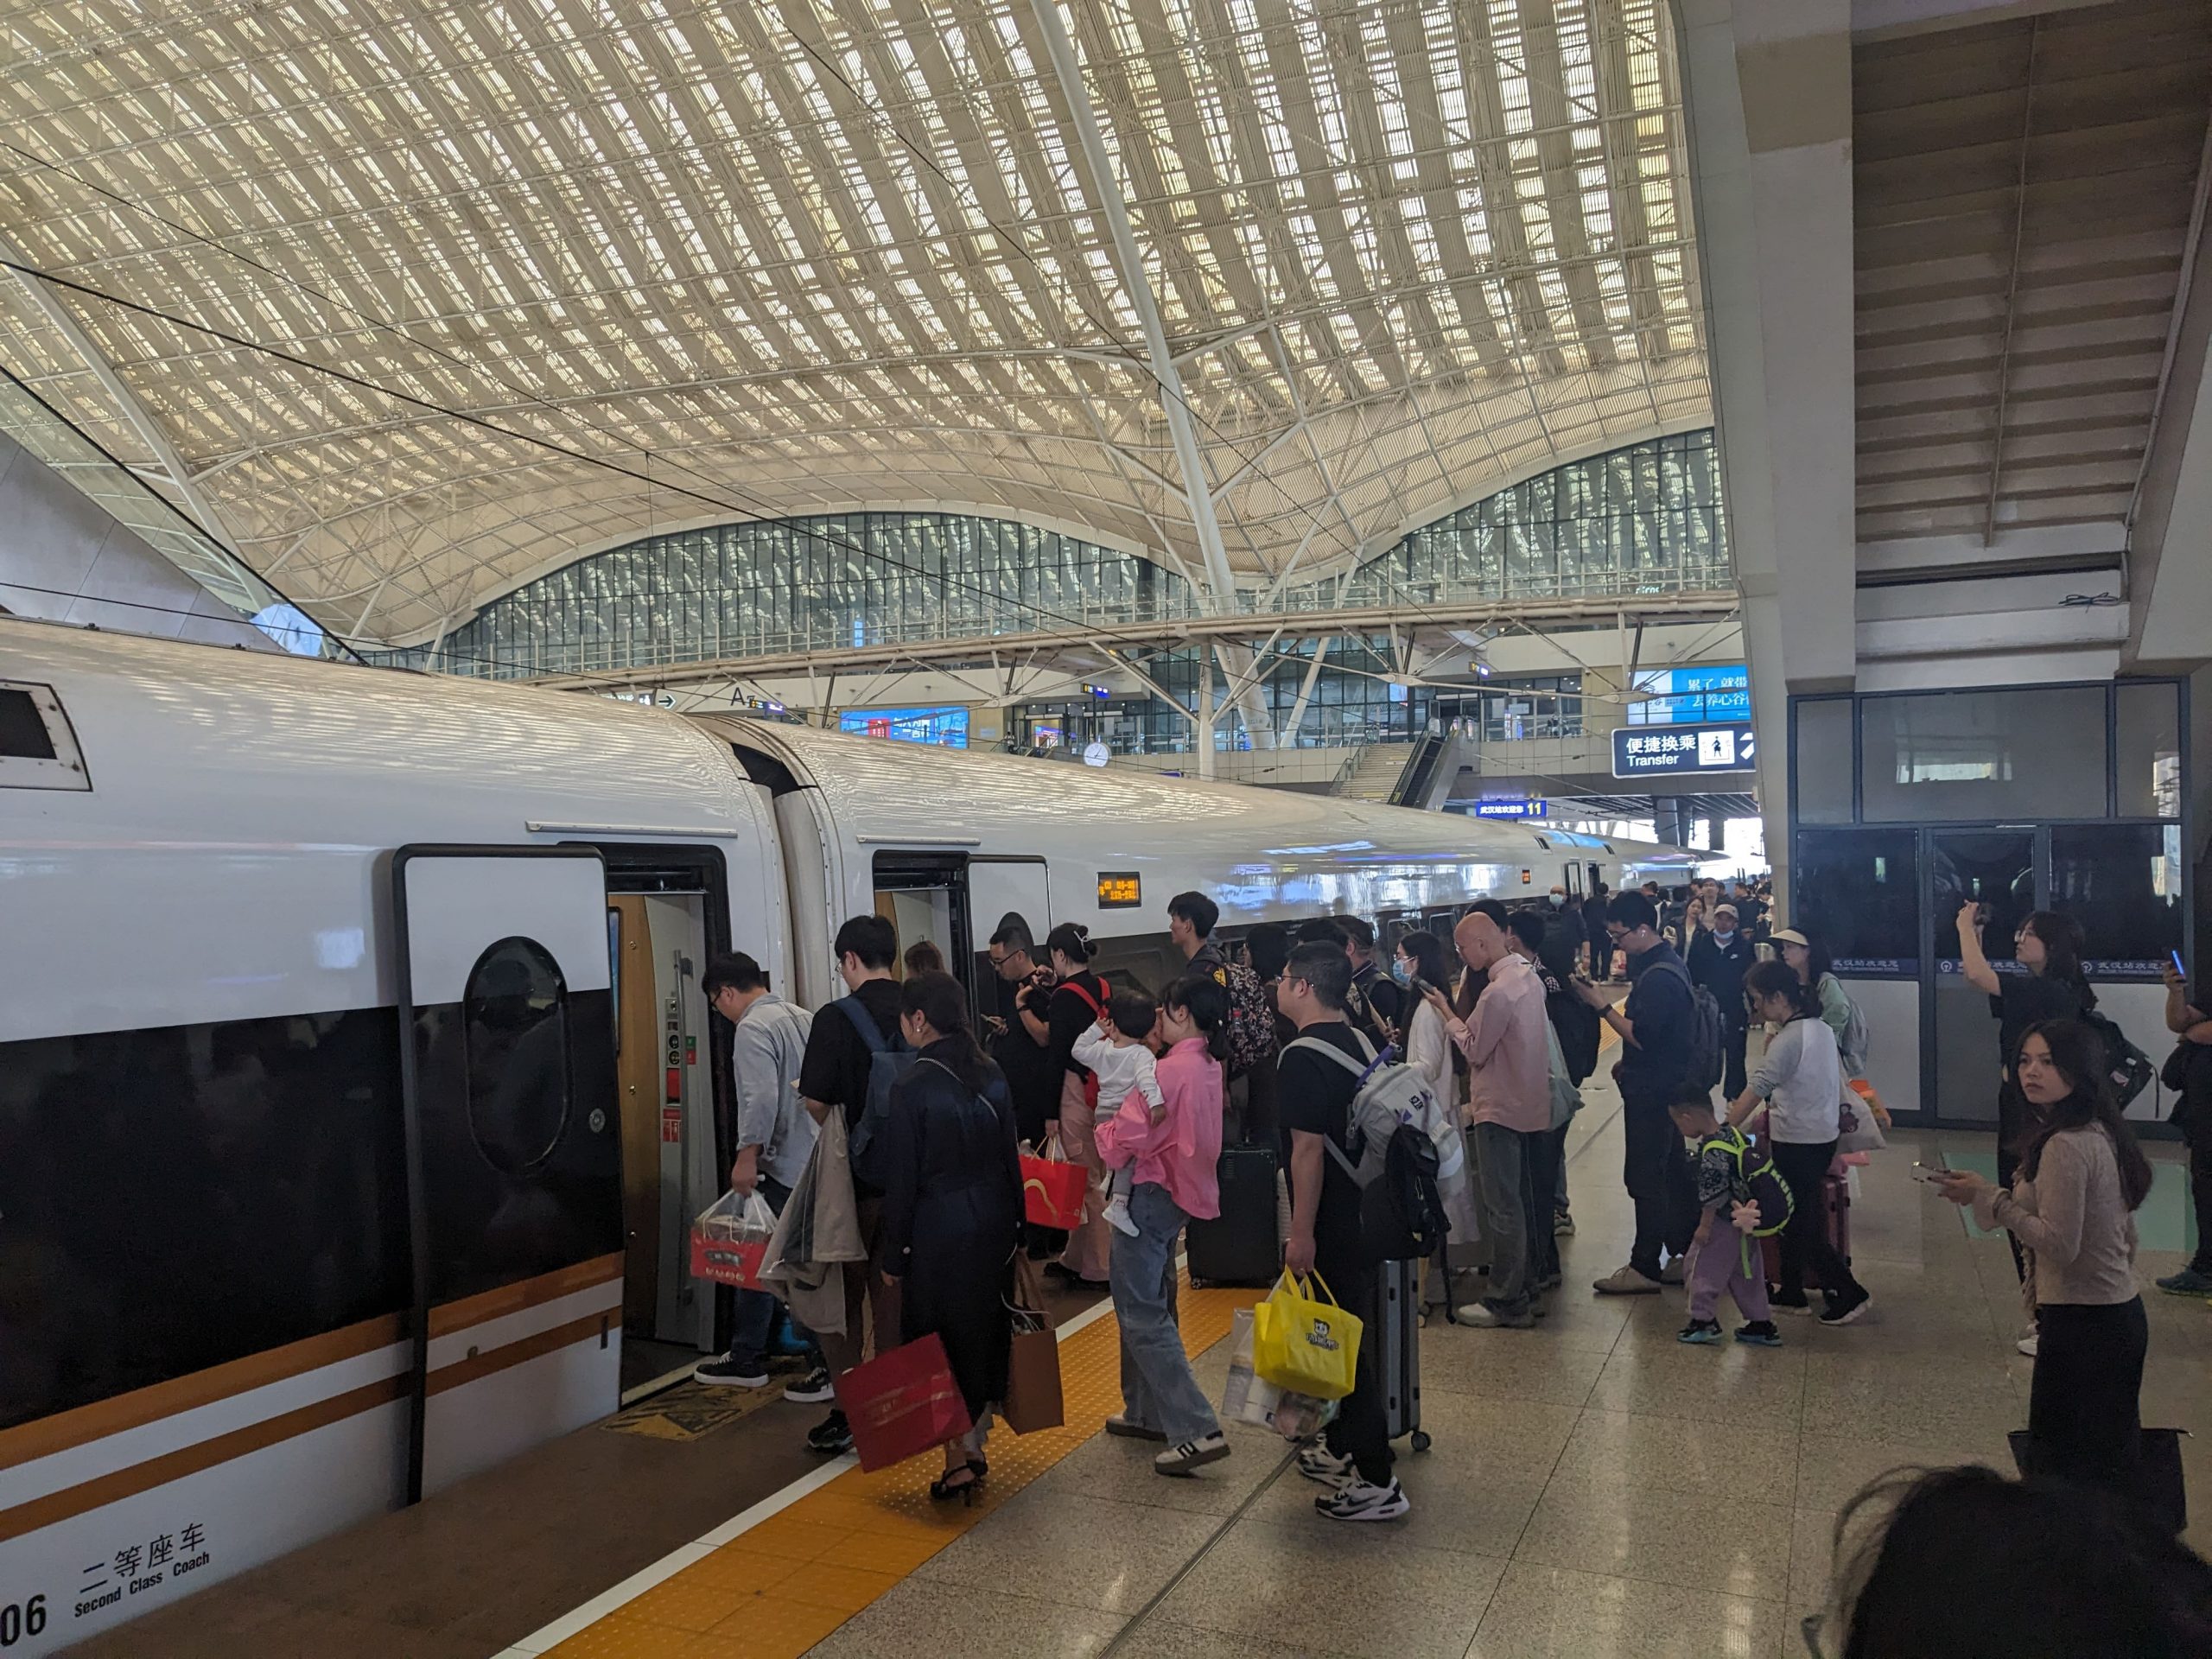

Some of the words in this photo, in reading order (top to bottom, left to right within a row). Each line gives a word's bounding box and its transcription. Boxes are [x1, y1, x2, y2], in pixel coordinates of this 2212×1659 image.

[1626, 734, 1696, 754] 便捷换乘
[1626, 753, 1680, 767] Transfer
[1528, 802, 1541, 816] 11
[79, 1522, 206, 1593] 二等座车
[74, 1586, 122, 1618] Second
[129, 1572, 163, 1595] Class
[173, 1551, 210, 1577] Coach
[0, 1593, 47, 1647] 06
